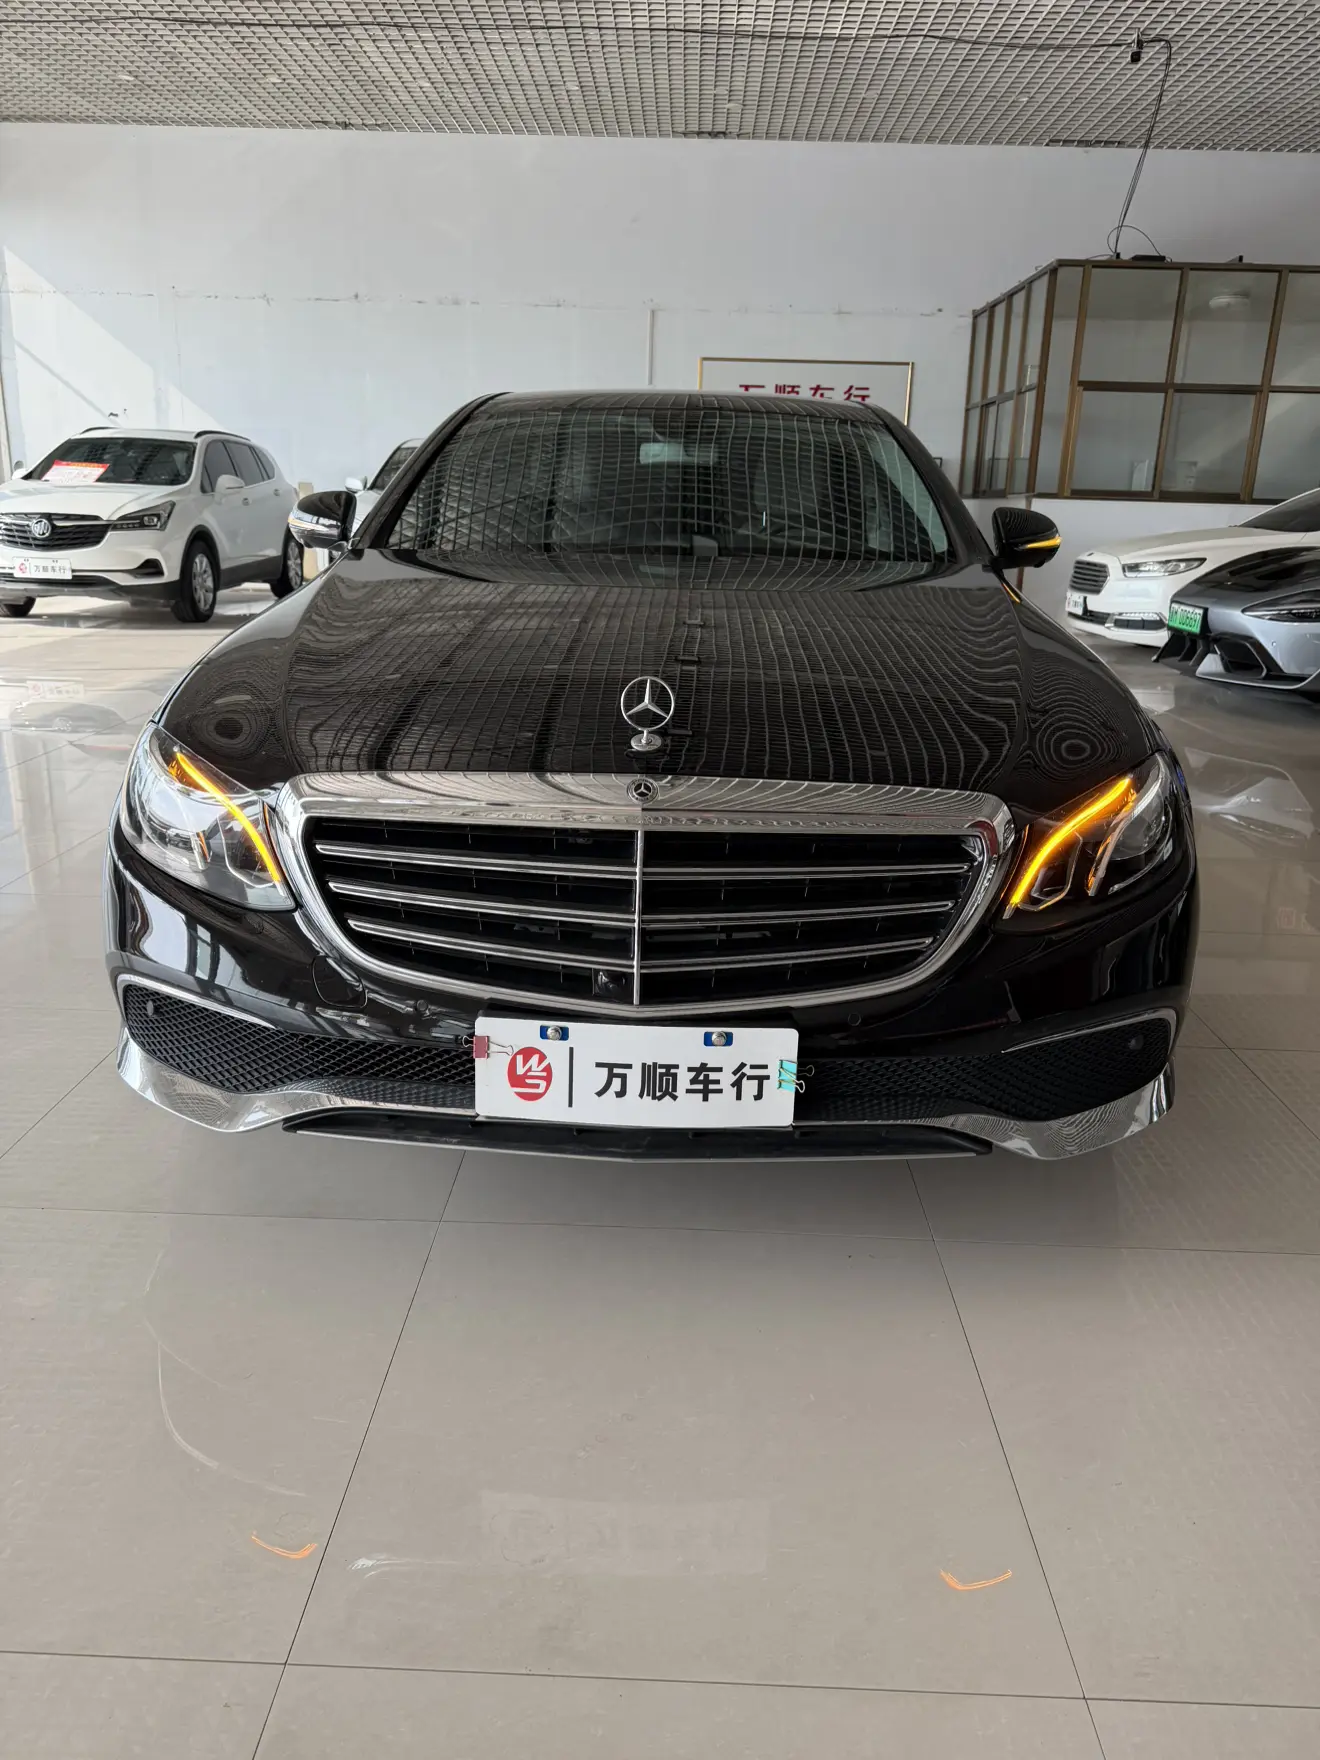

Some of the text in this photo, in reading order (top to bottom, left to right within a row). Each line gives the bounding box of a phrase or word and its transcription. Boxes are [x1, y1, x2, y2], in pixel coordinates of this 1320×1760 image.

[739, 384, 870, 401] 顺车行
[595, 1062, 770, 1102] 万顺车行
